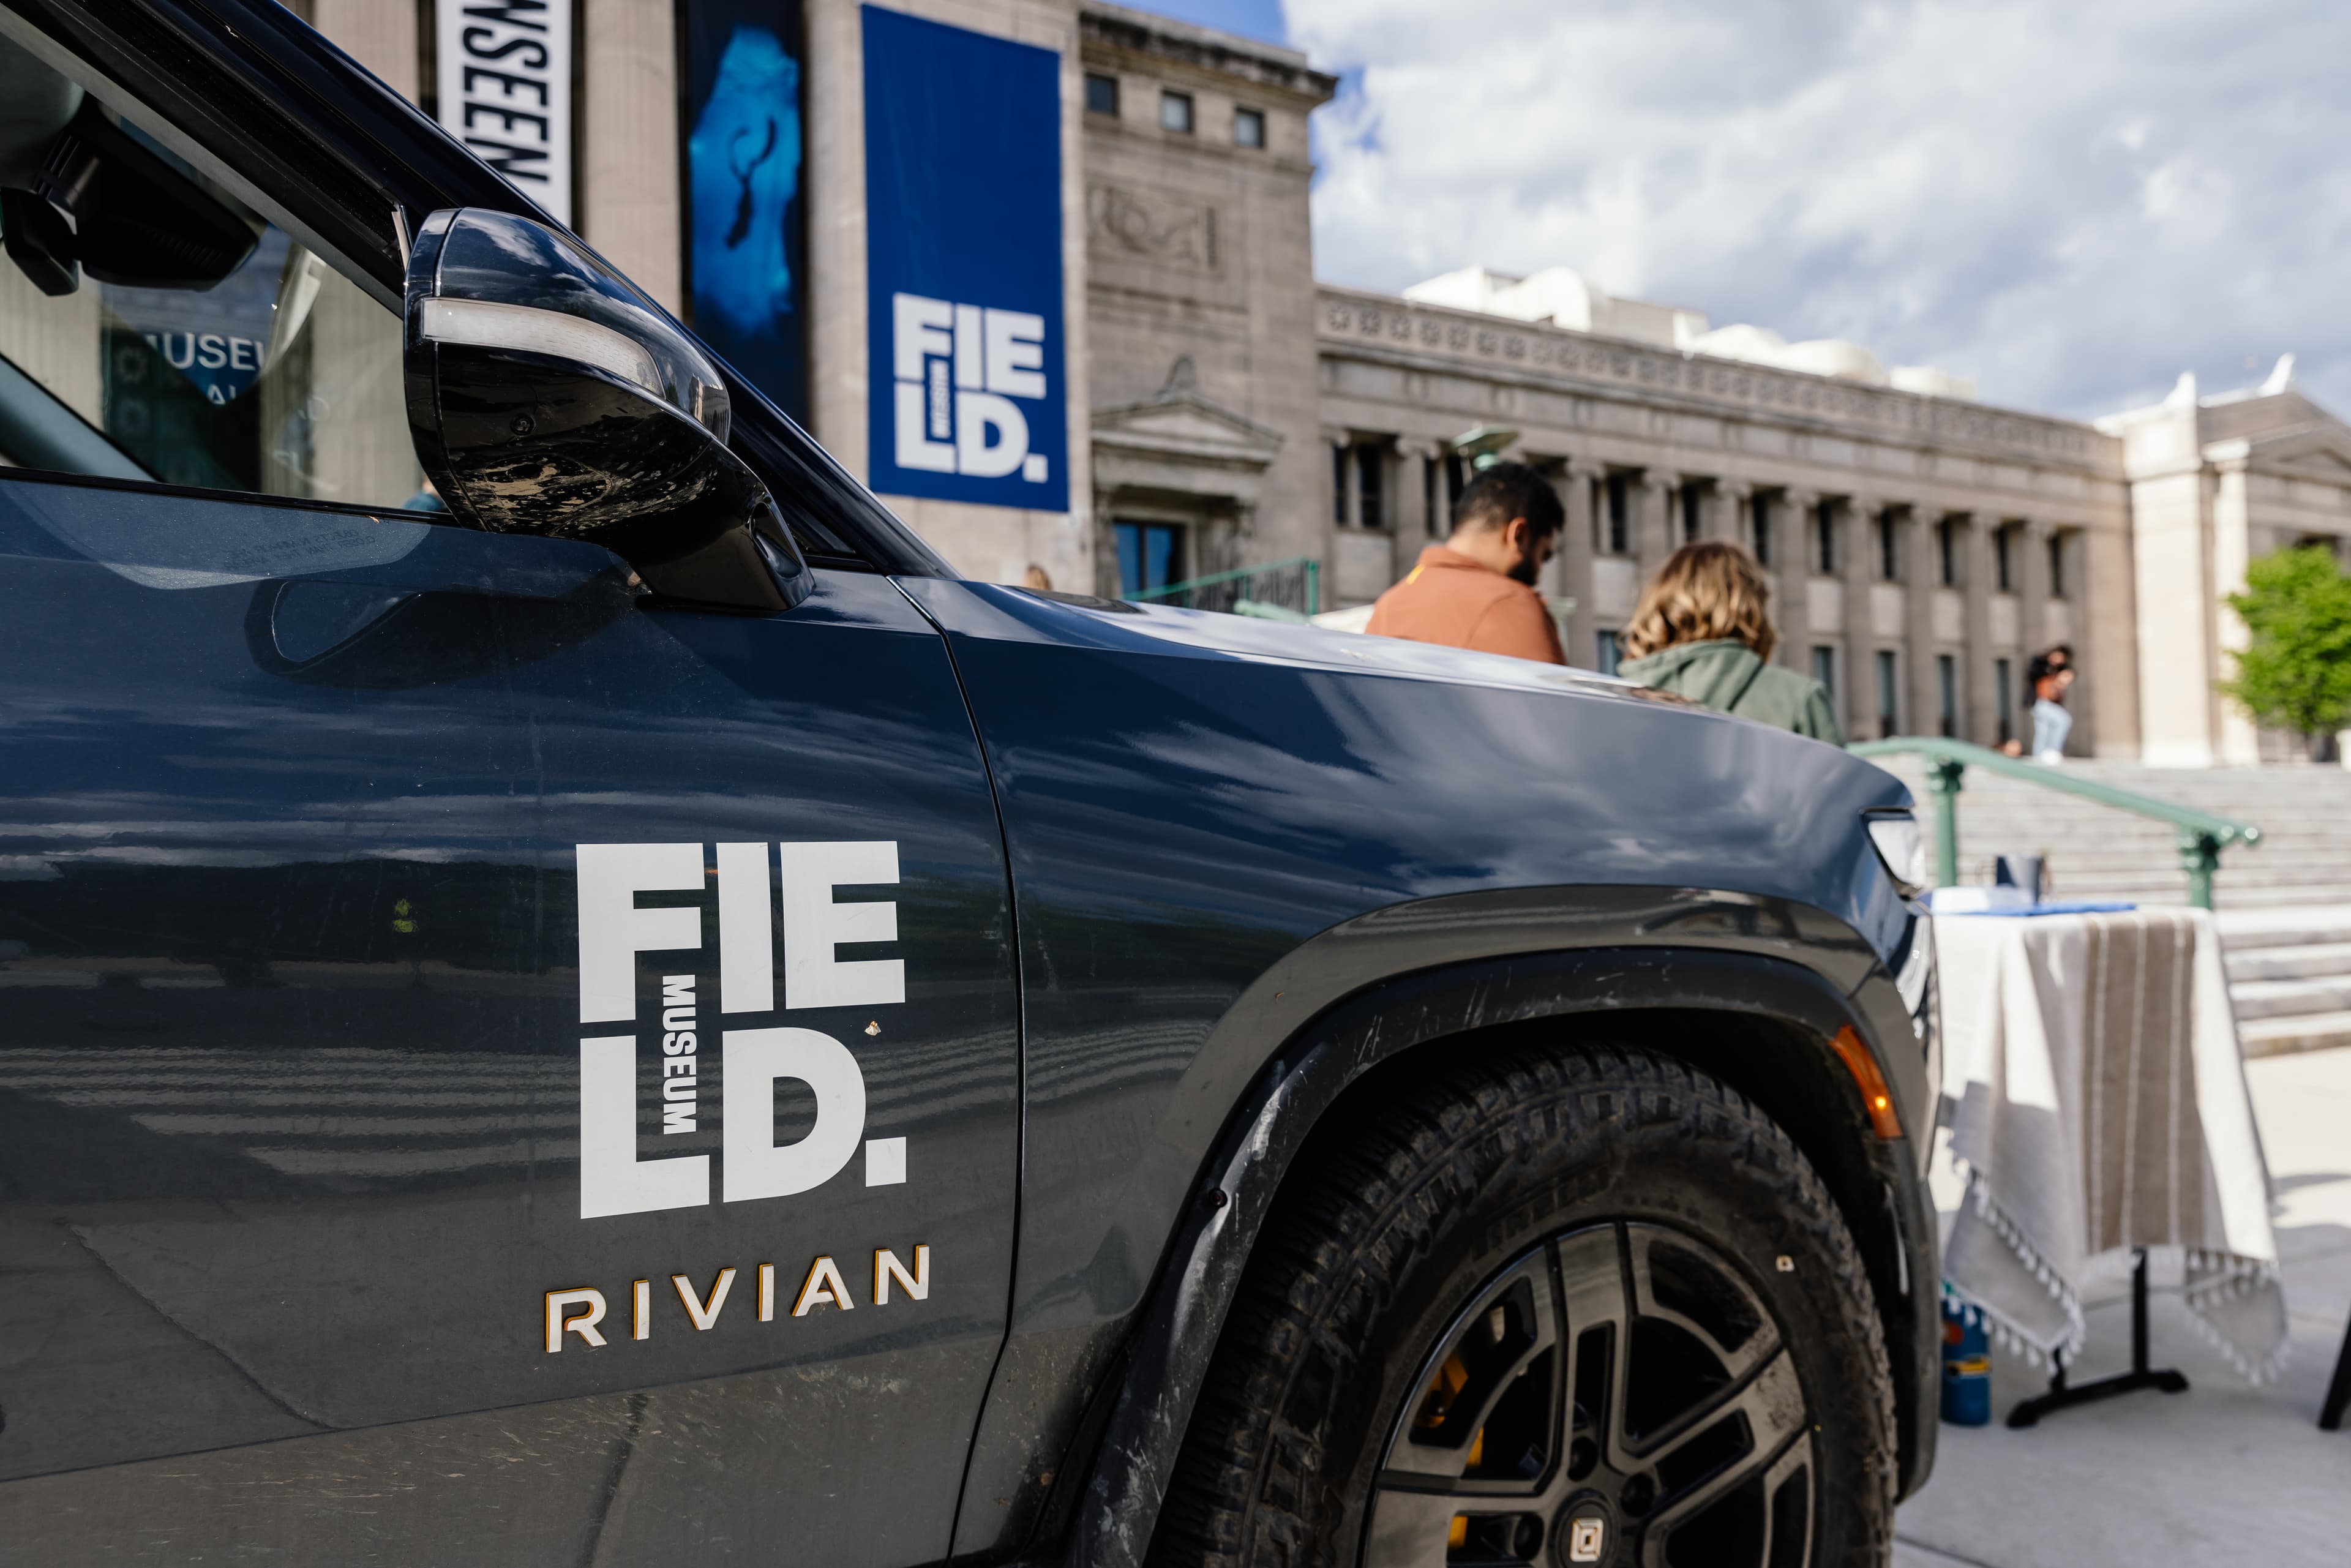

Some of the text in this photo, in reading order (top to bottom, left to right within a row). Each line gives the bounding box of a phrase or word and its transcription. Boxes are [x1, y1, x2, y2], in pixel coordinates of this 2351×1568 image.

[576, 841, 906, 1023] FIE
[662, 974, 697, 1135] MUSEUM
[544, 1244, 930, 1354] RIVIAN
